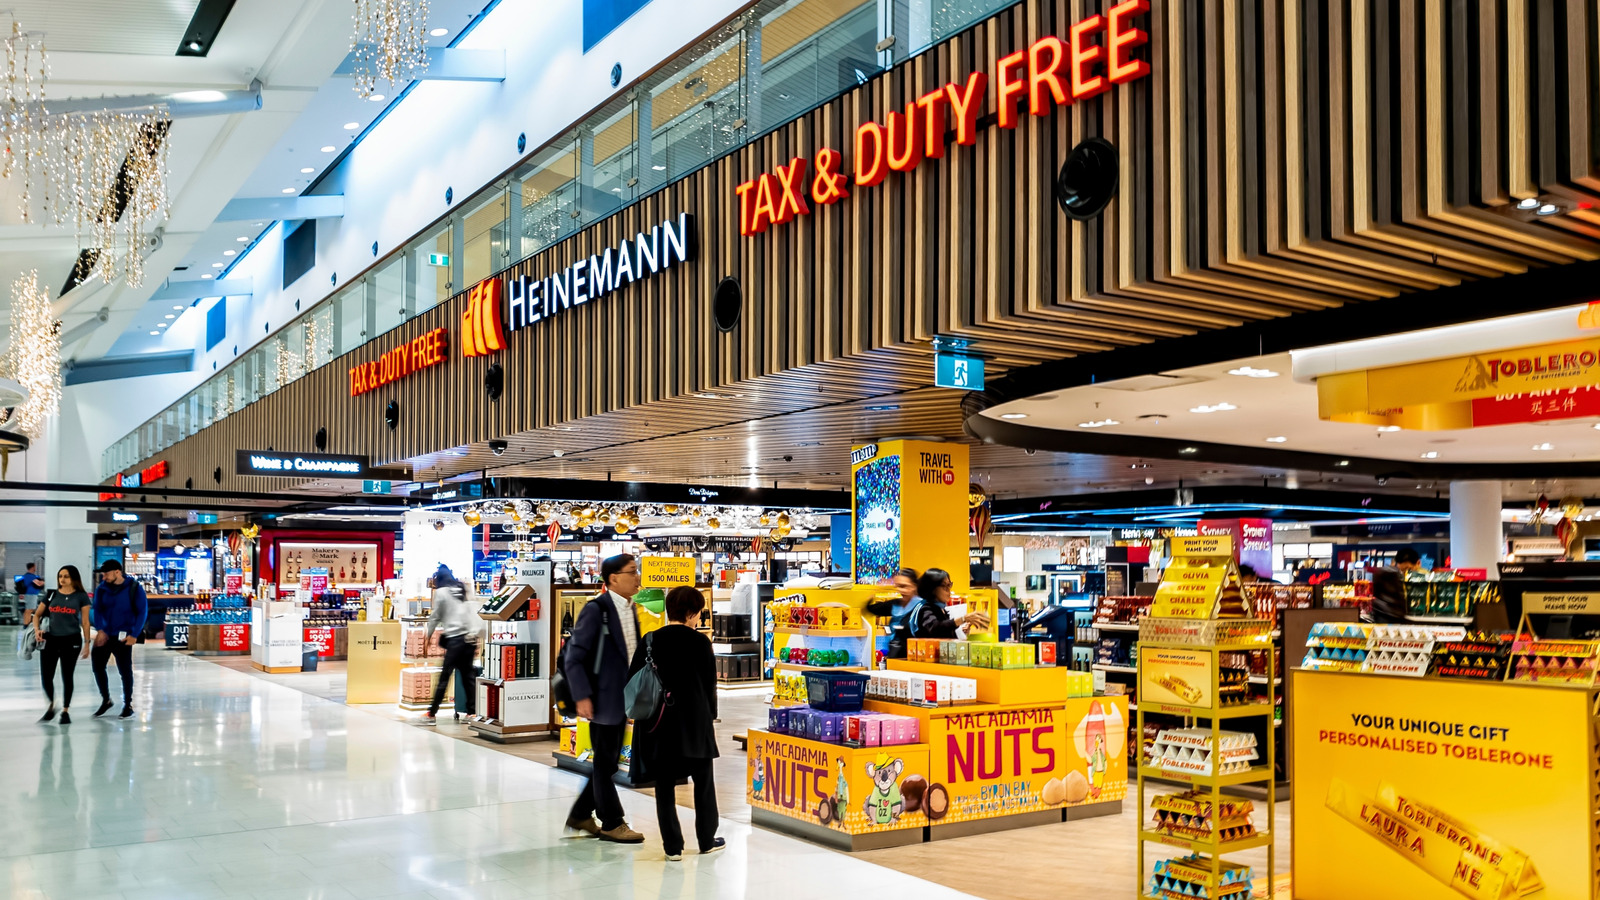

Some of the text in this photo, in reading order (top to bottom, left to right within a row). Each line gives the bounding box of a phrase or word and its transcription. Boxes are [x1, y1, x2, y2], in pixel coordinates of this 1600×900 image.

[736, 0, 1150, 236] TAX & DUTY FREE
[509, 212, 687, 331] HEINEMANN
[349, 328, 442, 397] TAX & DUTY FREE
[1488, 349, 1600, 383] TOBLERO
[1531, 396, 1577, 415] 买三件
[251, 455, 282, 469] WINE
[294, 458, 360, 473] CHAMPAGNE
[919, 452, 954, 469] TRAVEL
[919, 468, 942, 485] WITH
[1243, 524, 1267, 538] SYDNEY
[648, 574, 690, 583] 1500 MILES
[1502, 566, 1524, 574] Lenovo
[49, 605, 77, 615] adidas
[1170, 608, 1197, 616] STACY
[1155, 625, 1199, 636] TOBLERONE
[1378, 640, 1425, 650] TOBLERONE
[1445, 642, 1497, 654] TOBLERONE
[1372, 663, 1419, 673] TOBLERONE
[1438, 665, 1489, 678] TOBLERONE
[1161, 704, 1192, 714] TOBLERONE
[945, 708, 1054, 731] MACADAMIA
[1351, 713, 1509, 743] YOUR UNIQUE GIFT
[1163, 734, 1206, 747] TOBLERONE
[765, 739, 829, 767] MACADAMIA
[947, 725, 1055, 784] NUTS
[1319, 729, 1554, 770] PERSONALISED TOBLERONE
[1161, 757, 1205, 771] TOBLERONE
[1161, 771, 1192, 780] TOBLERONE
[765, 757, 829, 817] NUTS
[981, 783, 1011, 801] BYRON
[1013, 781, 1031, 797] BAY
[878, 808, 888, 818] OZ
[963, 796, 1038, 815] HINTERLAND AUSTRALIA
[1360, 803, 1426, 858] LAURA
[1164, 864, 1208, 881] TOBLERONE
